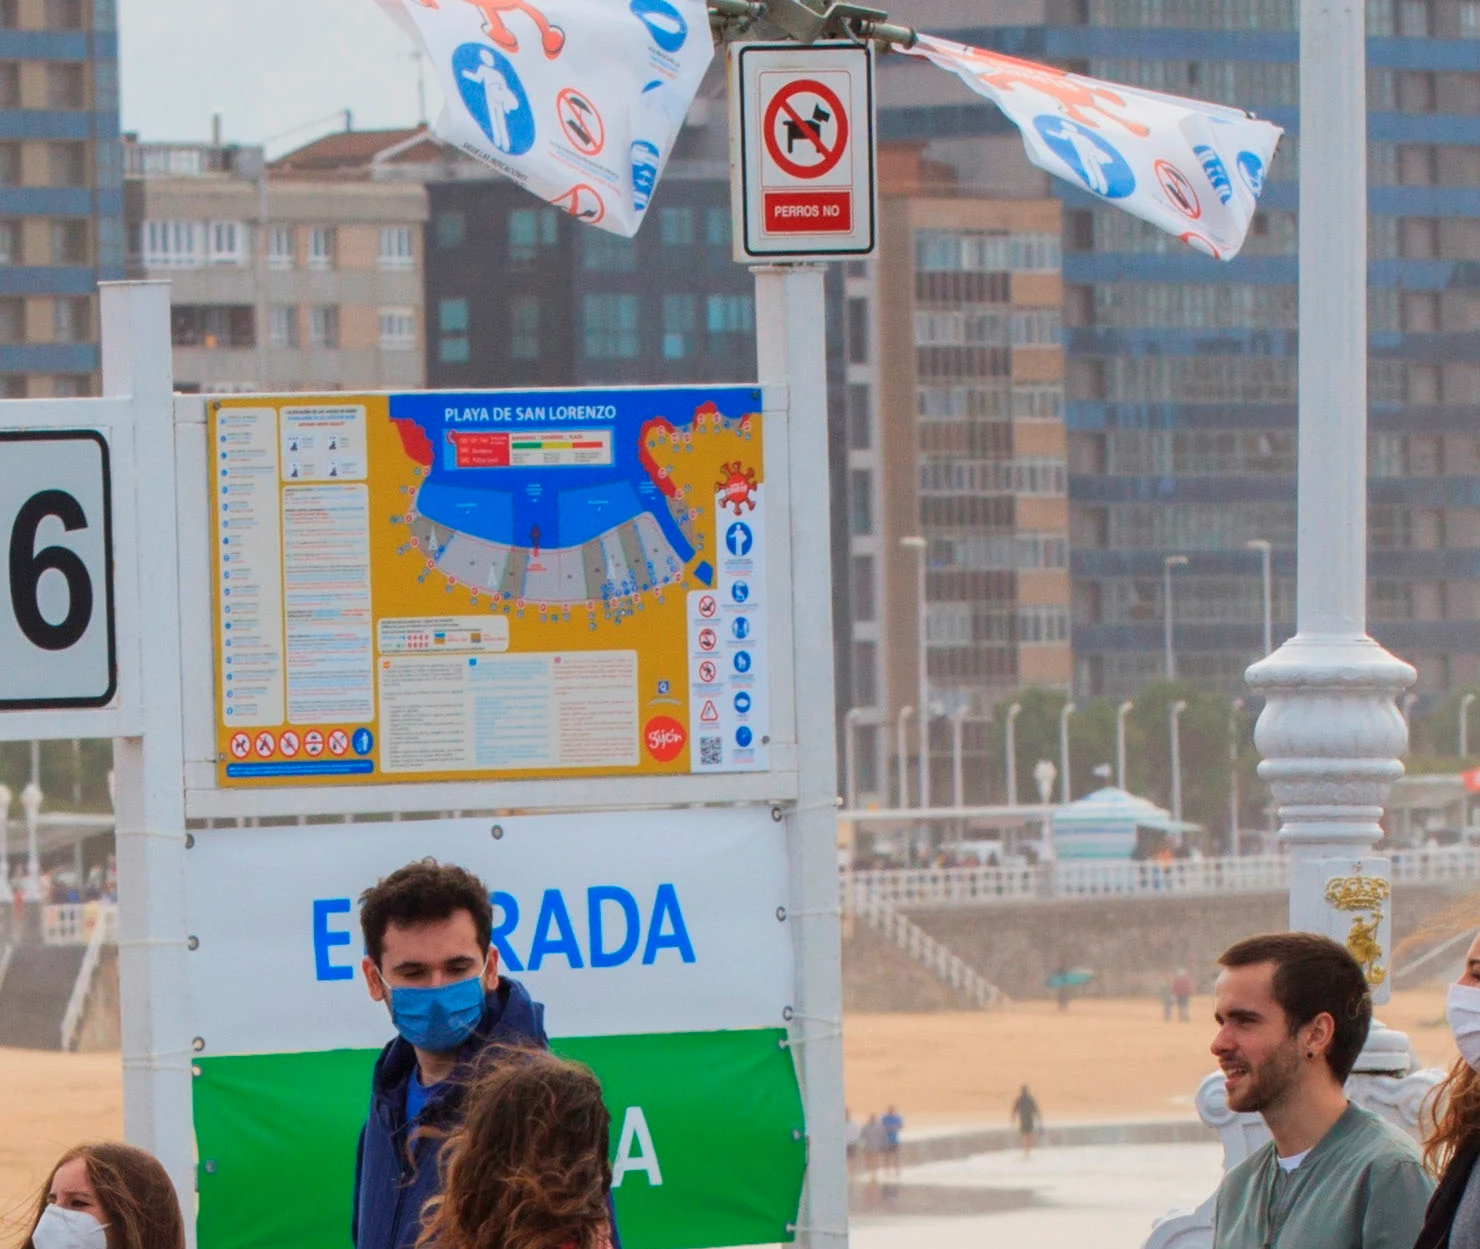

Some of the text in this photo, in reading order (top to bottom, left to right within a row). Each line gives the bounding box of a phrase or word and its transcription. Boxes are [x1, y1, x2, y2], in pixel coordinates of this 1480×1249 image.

[774, 204, 840, 217] PERROS NO
[445, 405, 617, 422] PLAYA DE SAN LORENZO
